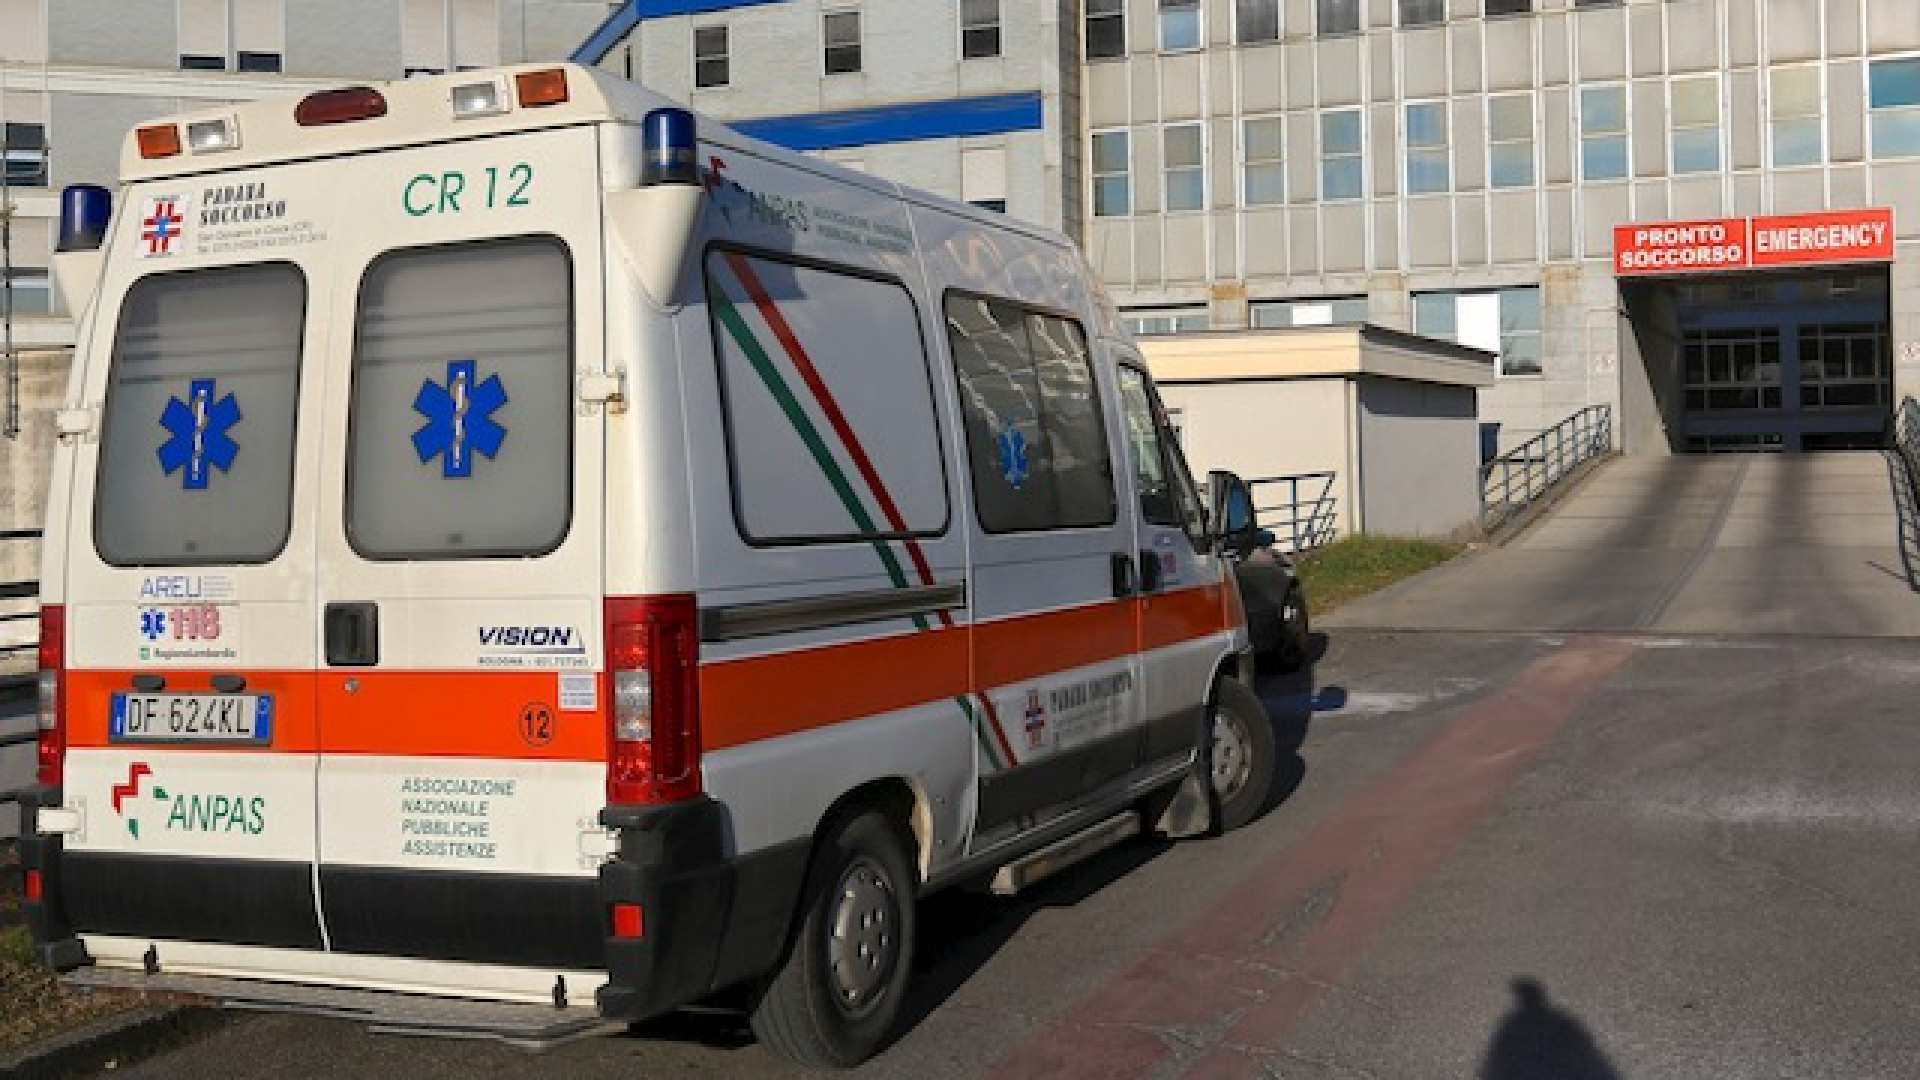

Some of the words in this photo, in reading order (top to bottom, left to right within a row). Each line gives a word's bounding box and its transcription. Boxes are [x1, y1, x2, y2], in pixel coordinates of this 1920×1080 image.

[403, 170, 466, 217] CR
[484, 162, 534, 208] 12
[200, 200, 287, 226] SOCCORSO
[1634, 224, 1726, 247] PRONTO
[1756, 221, 1887, 253] EMERGENCY
[1618, 243, 1742, 268] SOCCORSO
[168, 603, 222, 640] 118
[478, 625, 573, 646] VISION
[128, 698, 160, 733] DF
[168, 698, 250, 733] 624KL
[522, 710, 550, 739] 12
[400, 776, 517, 796] ASSOCIAZIONE
[165, 794, 265, 835] ANPAS
[401, 798, 490, 816] NAZIONALE
[401, 818, 490, 837] PUBBLICHE
[401, 839, 498, 859] ASSISTENZE
